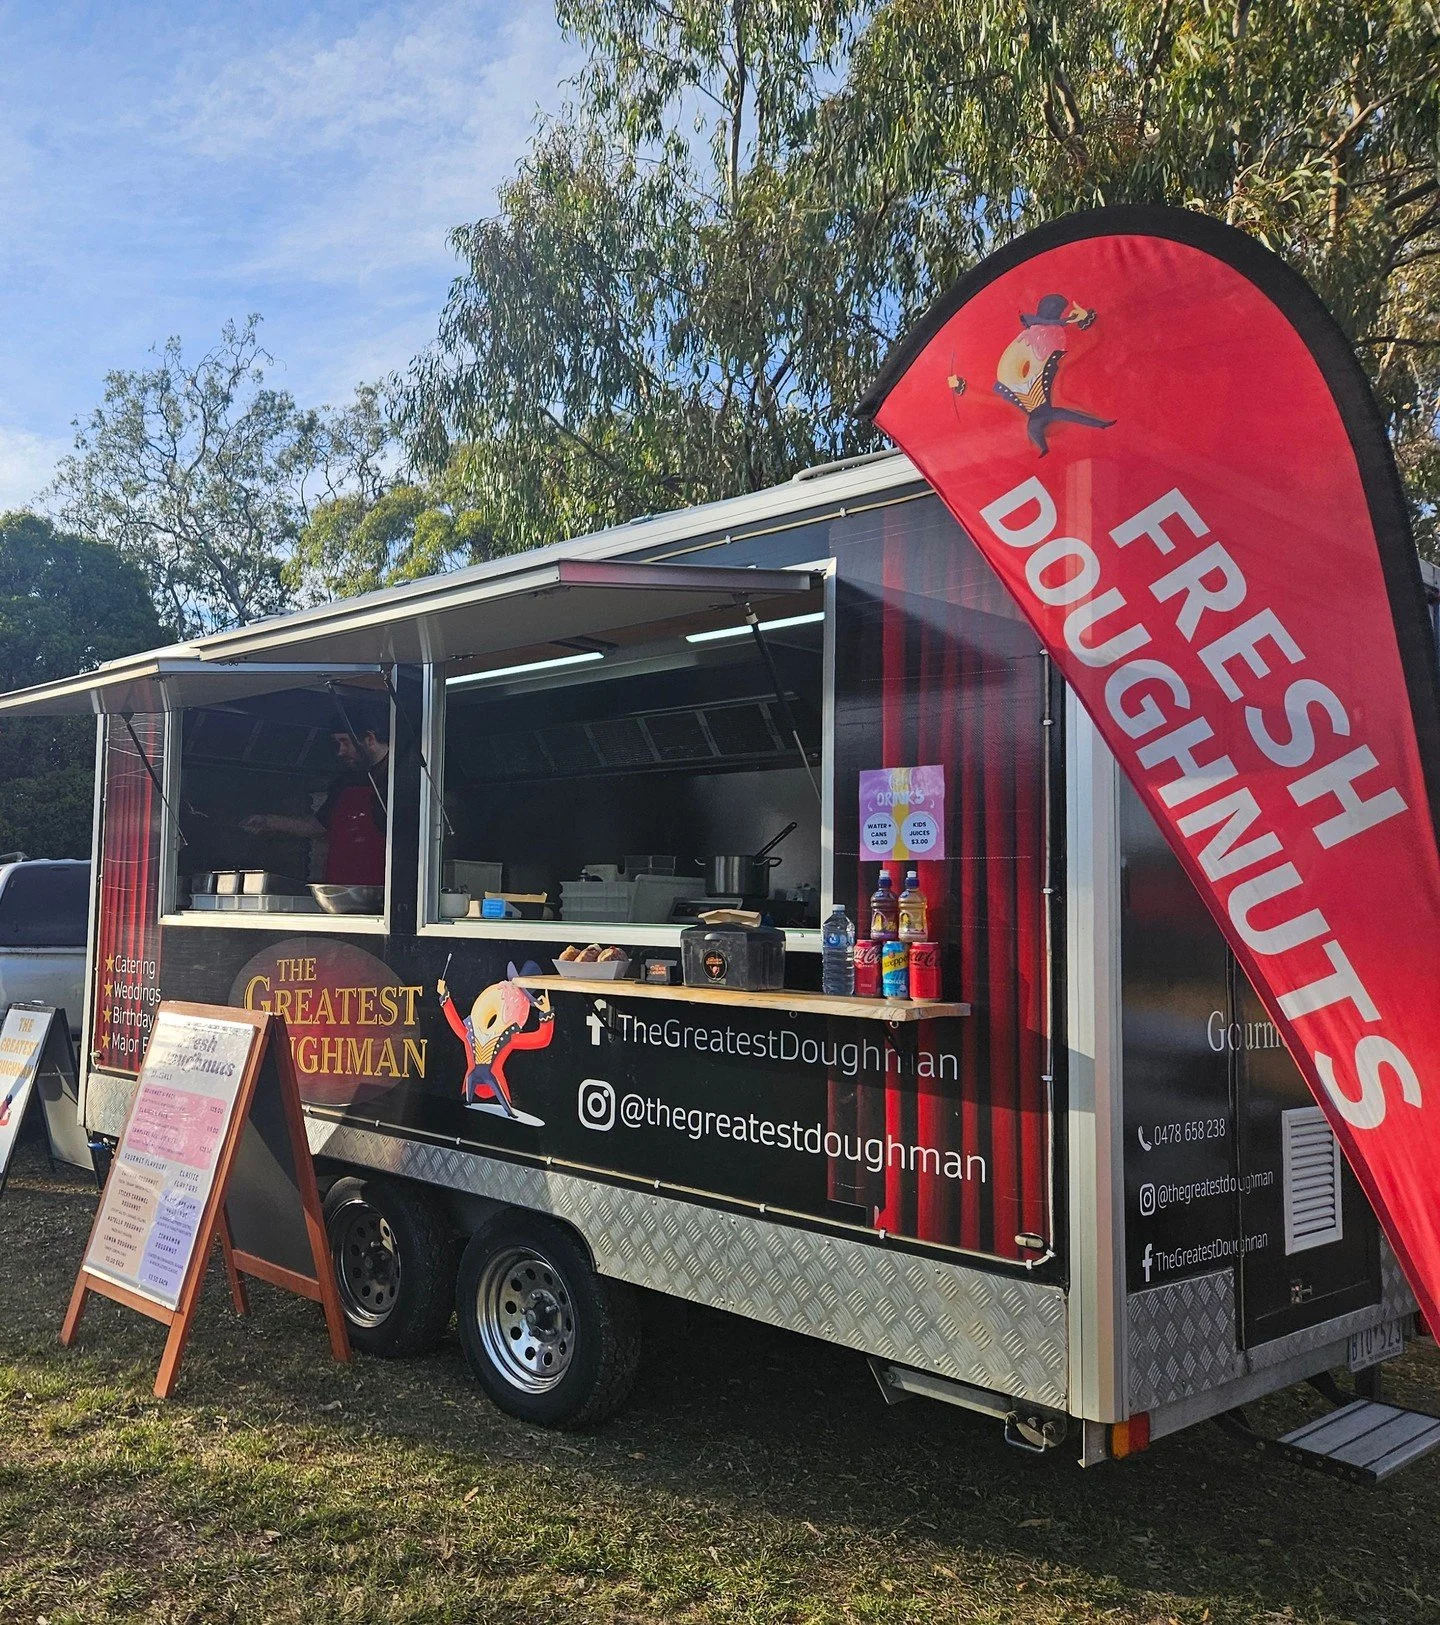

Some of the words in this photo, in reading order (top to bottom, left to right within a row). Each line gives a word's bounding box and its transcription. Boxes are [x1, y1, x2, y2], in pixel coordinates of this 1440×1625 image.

[1108, 485, 1410, 850] FRESH
[978, 475, 1423, 1131] DOUGHNUTS
[909, 829, 930, 837] JUICES
[114, 955, 155, 979] Catering
[277, 957, 317, 982] THE
[114, 981, 161, 1006] Weddings
[243, 975, 423, 1026] GREATEST
[112, 1032, 139, 1055] Major
[1207, 1010, 1288, 1052] Gourm
[620, 1092, 986, 1184] @thegreatestdoughman
[1154, 1123, 1181, 1146] 0478
[1185, 1120, 1204, 1141] 658
[1207, 1118, 1226, 1138] 238
[179, 1170, 199, 1180] CLASSIC
[1157, 1170, 1274, 1209] @thegreatestdoughman
[1156, 1232, 1268, 1271] TheGreatestDoughman
